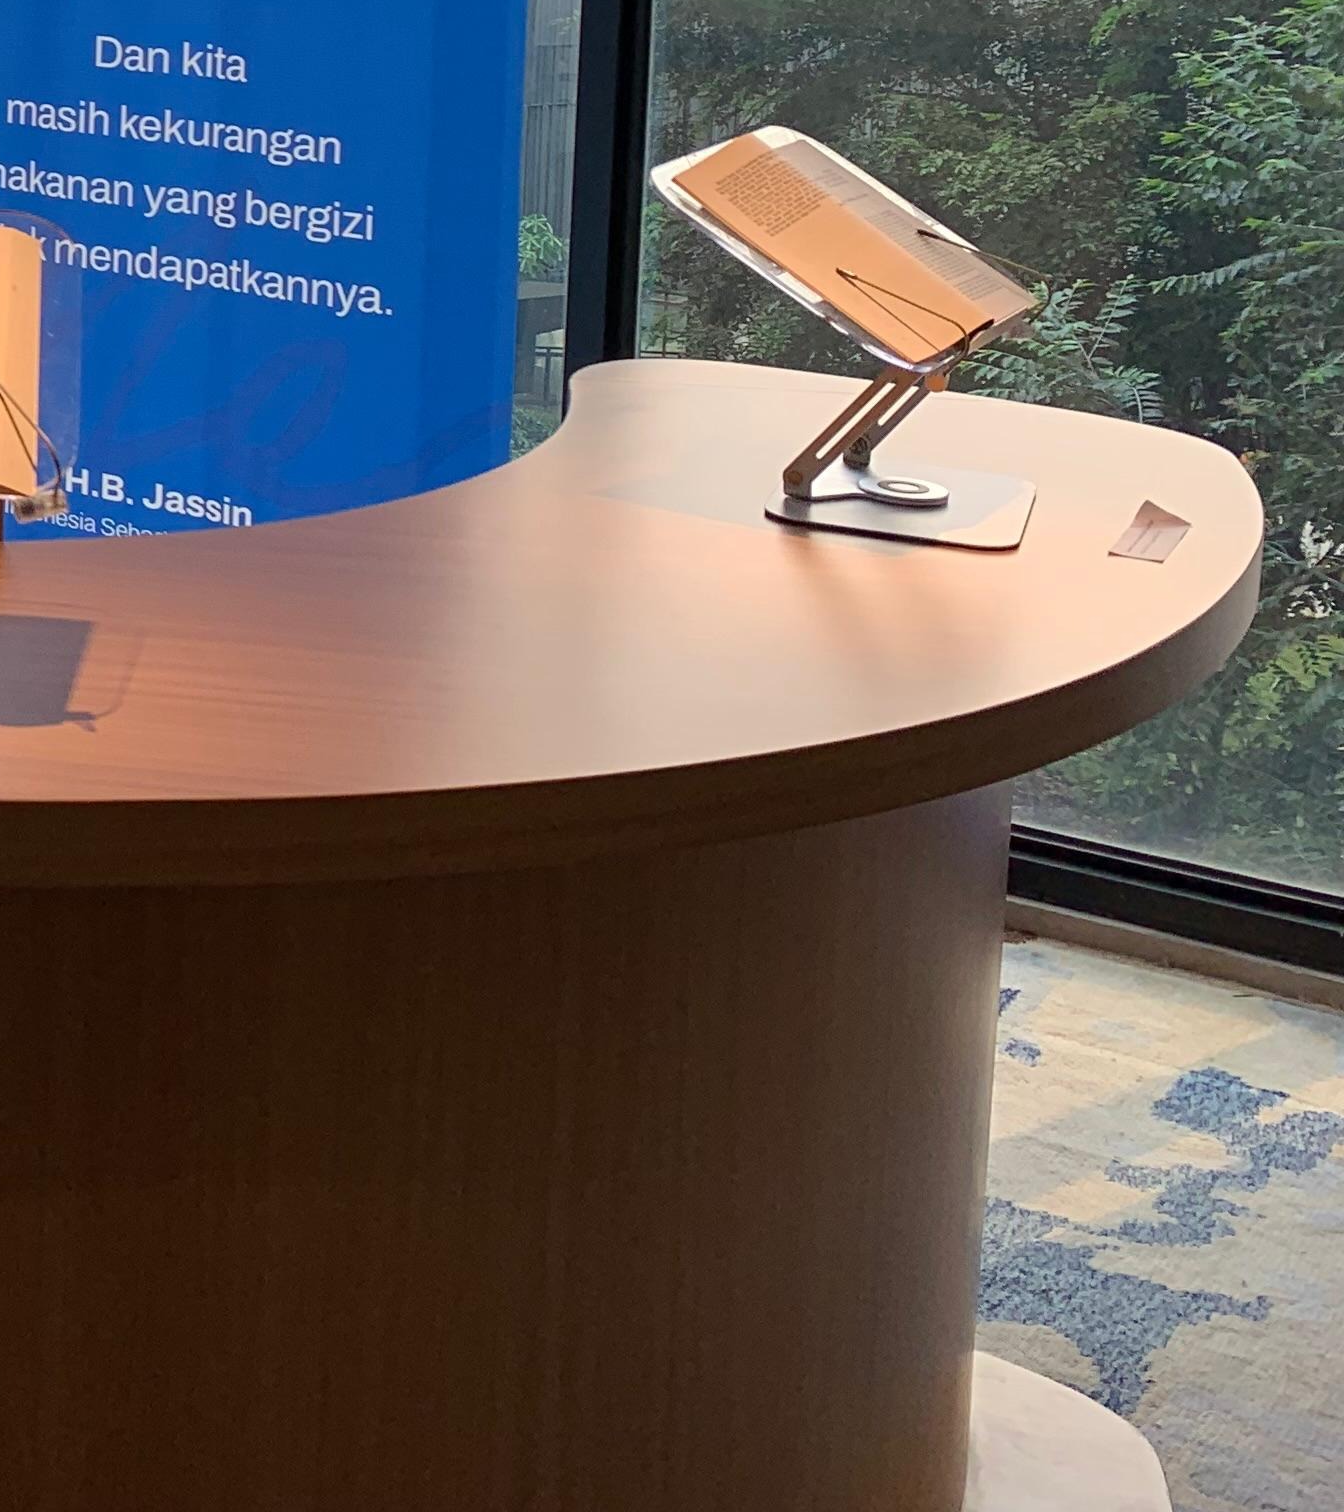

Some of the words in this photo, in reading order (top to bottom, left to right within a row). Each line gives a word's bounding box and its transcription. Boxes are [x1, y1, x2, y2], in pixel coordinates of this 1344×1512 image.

[95, 35, 170, 74] Dan
[182, 41, 248, 83] kita
[6, 99, 110, 136] masih
[119, 104, 341, 167] kekurangan
[143, 184, 238, 229] yang
[245, 189, 374, 243] bergizi
[54, 235, 393, 318] mendapatkannya.
[63, 466, 134, 506] H.B.
[142, 483, 252, 528] Jassin
